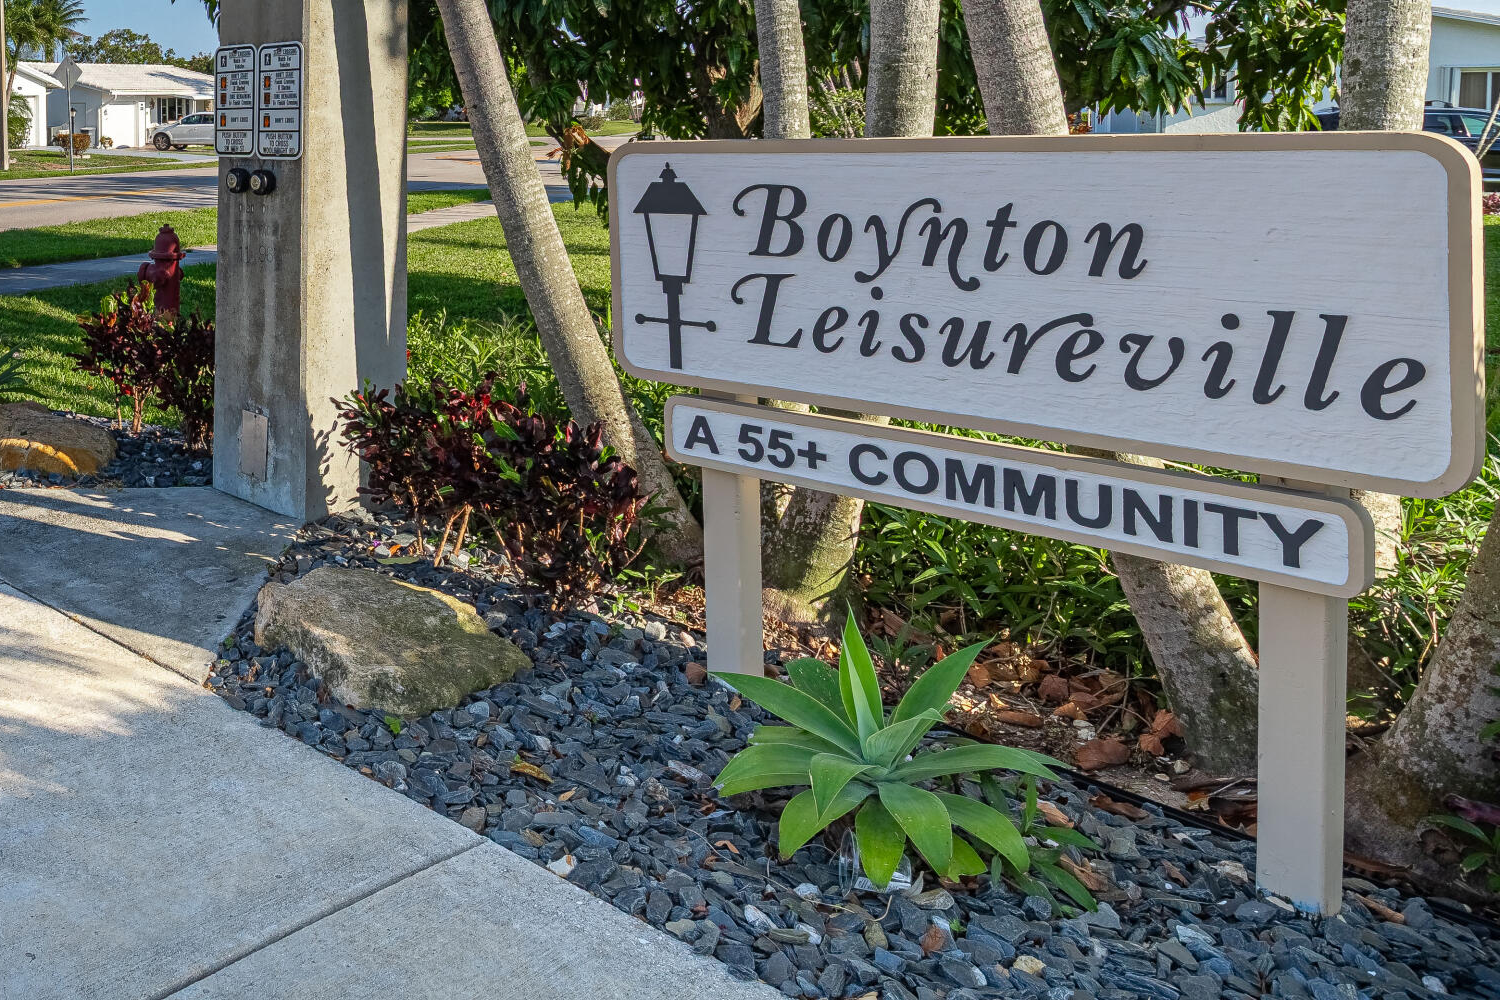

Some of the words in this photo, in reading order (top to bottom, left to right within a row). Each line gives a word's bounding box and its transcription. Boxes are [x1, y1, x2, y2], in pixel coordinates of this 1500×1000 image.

[732, 184, 1148, 291] Boynton
[730, 272, 1428, 421] Leisureville
[684, 416, 719, 455] A
[737, 425, 827, 471] 55+
[848, 443, 1325, 569] COMMUNITY
